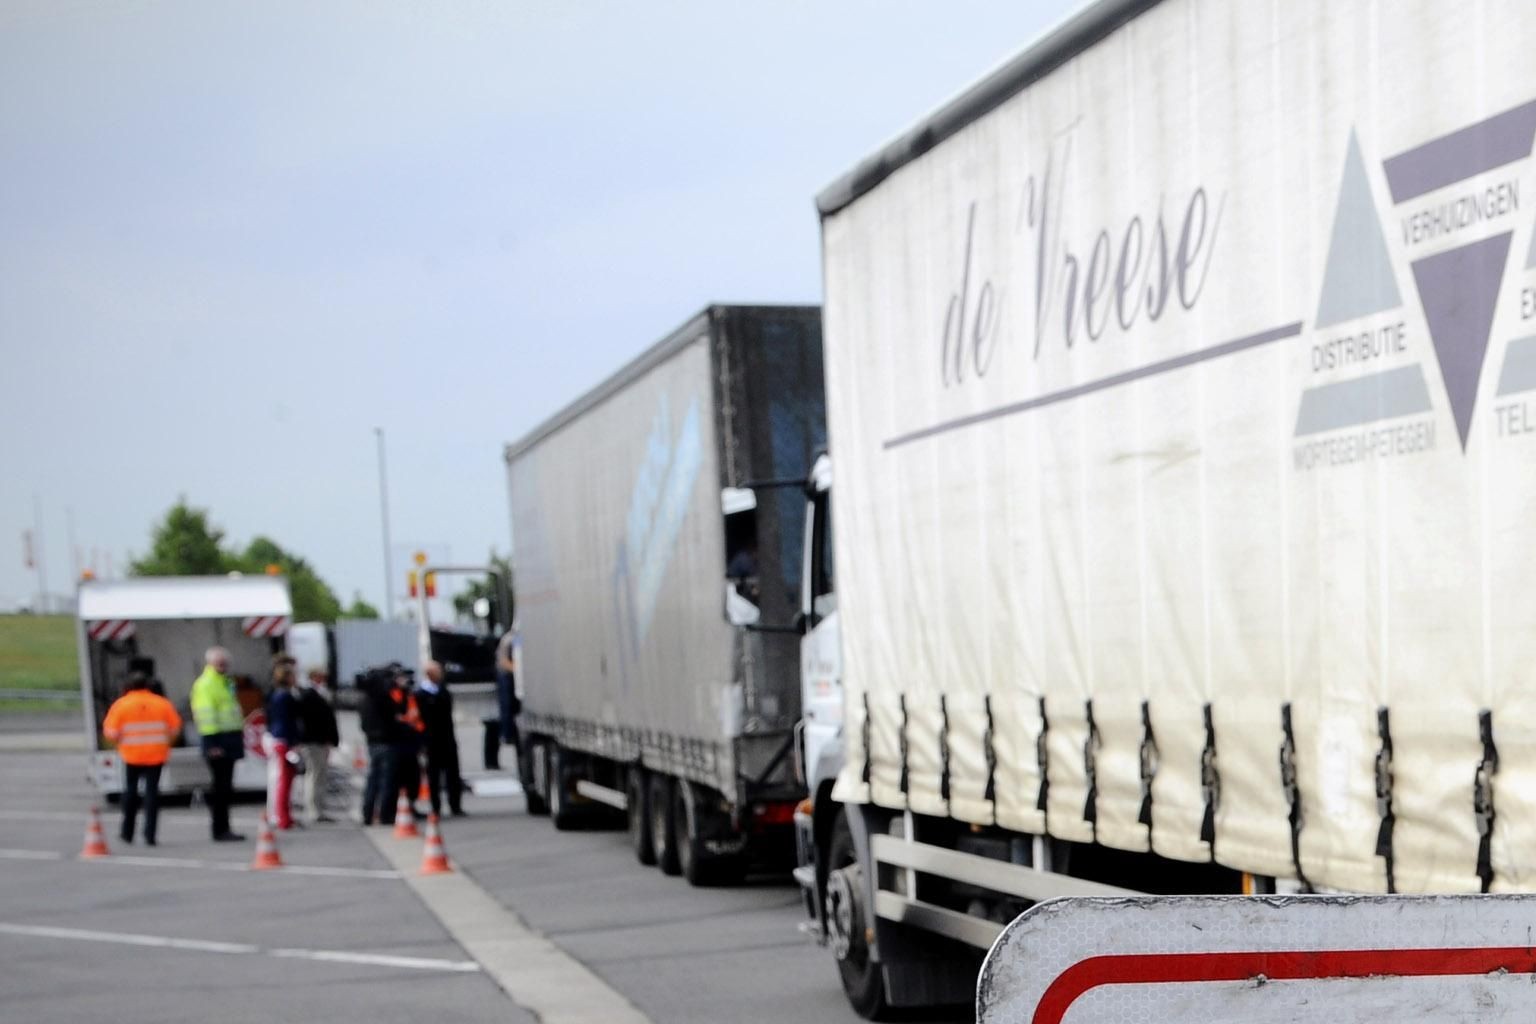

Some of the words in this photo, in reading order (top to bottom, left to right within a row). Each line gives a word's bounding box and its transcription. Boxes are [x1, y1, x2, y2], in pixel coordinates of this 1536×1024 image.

[1401, 179, 1520, 248] VERHUIZINGEN
[941, 202, 997, 388] de
[1018, 115, 1227, 360] Vreese
[1311, 321, 1407, 374] DISTRIBUTIE
